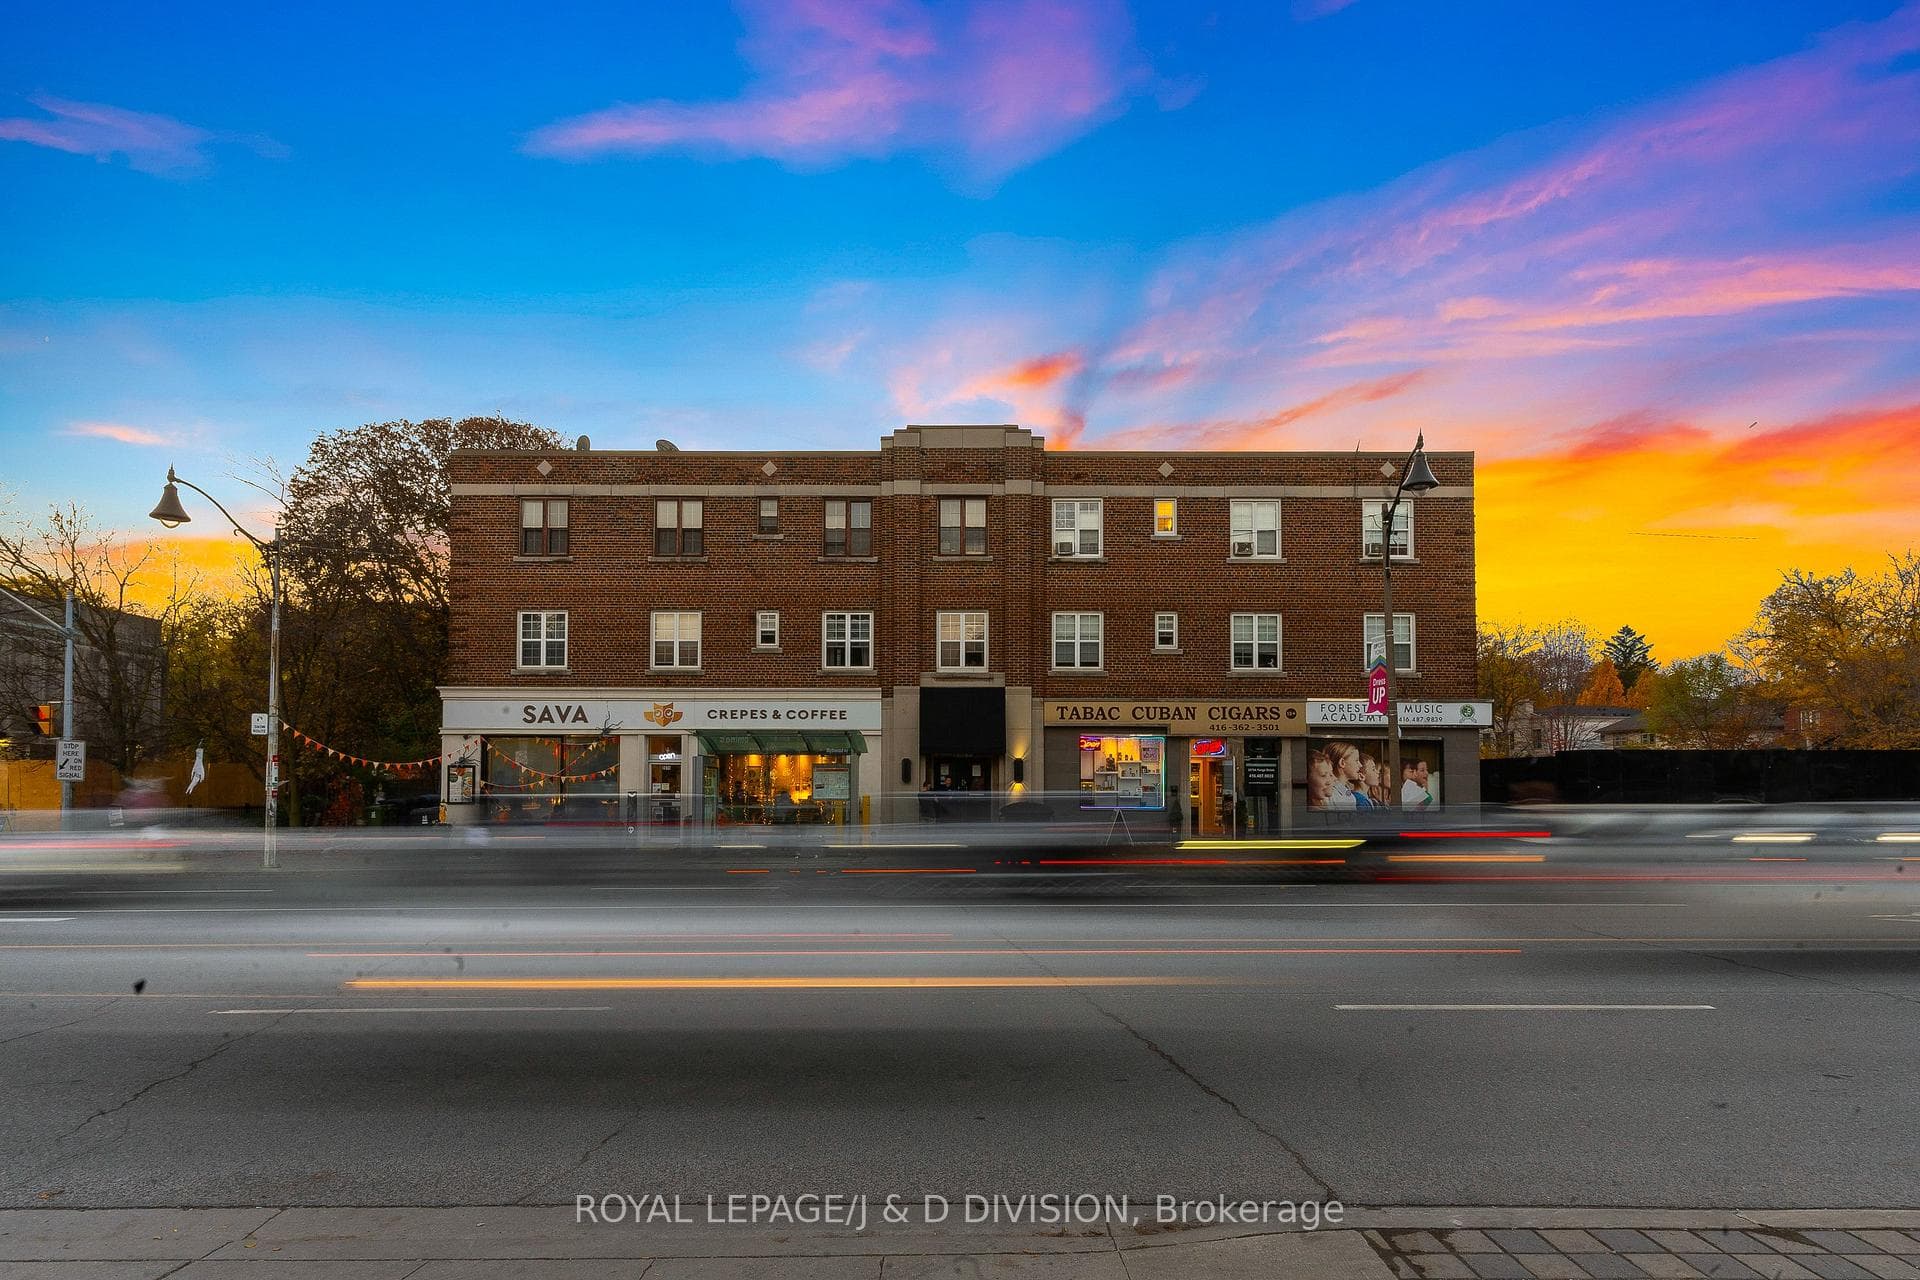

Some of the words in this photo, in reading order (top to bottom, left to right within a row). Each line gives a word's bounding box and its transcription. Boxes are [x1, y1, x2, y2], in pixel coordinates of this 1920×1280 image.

[1373, 687, 1386, 704] UP
[522, 705, 589, 724] SAVA
[707, 709, 768, 720] CREPES
[772, 709, 782, 720] &
[786, 709, 848, 720] COFFEE
[1056, 706, 1120, 720] TABAC
[1131, 706, 1197, 720] CUBAN
[1208, 706, 1281, 720] CIGARS
[1320, 703, 1368, 713] FOREST
[1404, 704, 1443, 714] MUSIC
